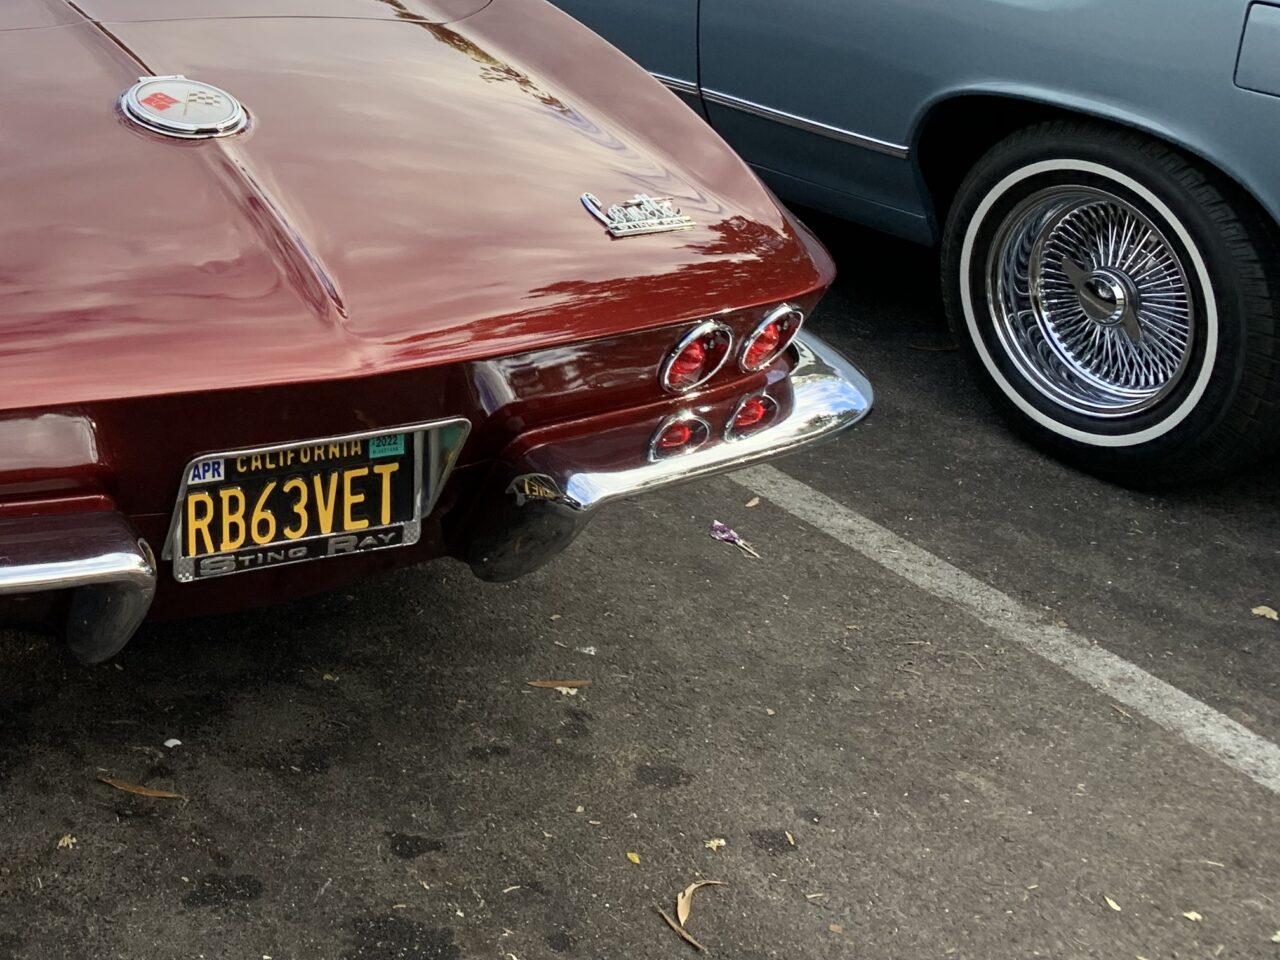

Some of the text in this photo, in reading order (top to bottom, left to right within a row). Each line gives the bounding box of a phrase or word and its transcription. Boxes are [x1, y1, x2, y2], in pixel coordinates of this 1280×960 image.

[375, 434, 399, 448] 2022
[235, 439, 362, 473] CALIFORNIA
[191, 460, 221, 482] APR
[187, 462, 400, 558] RB63VET
